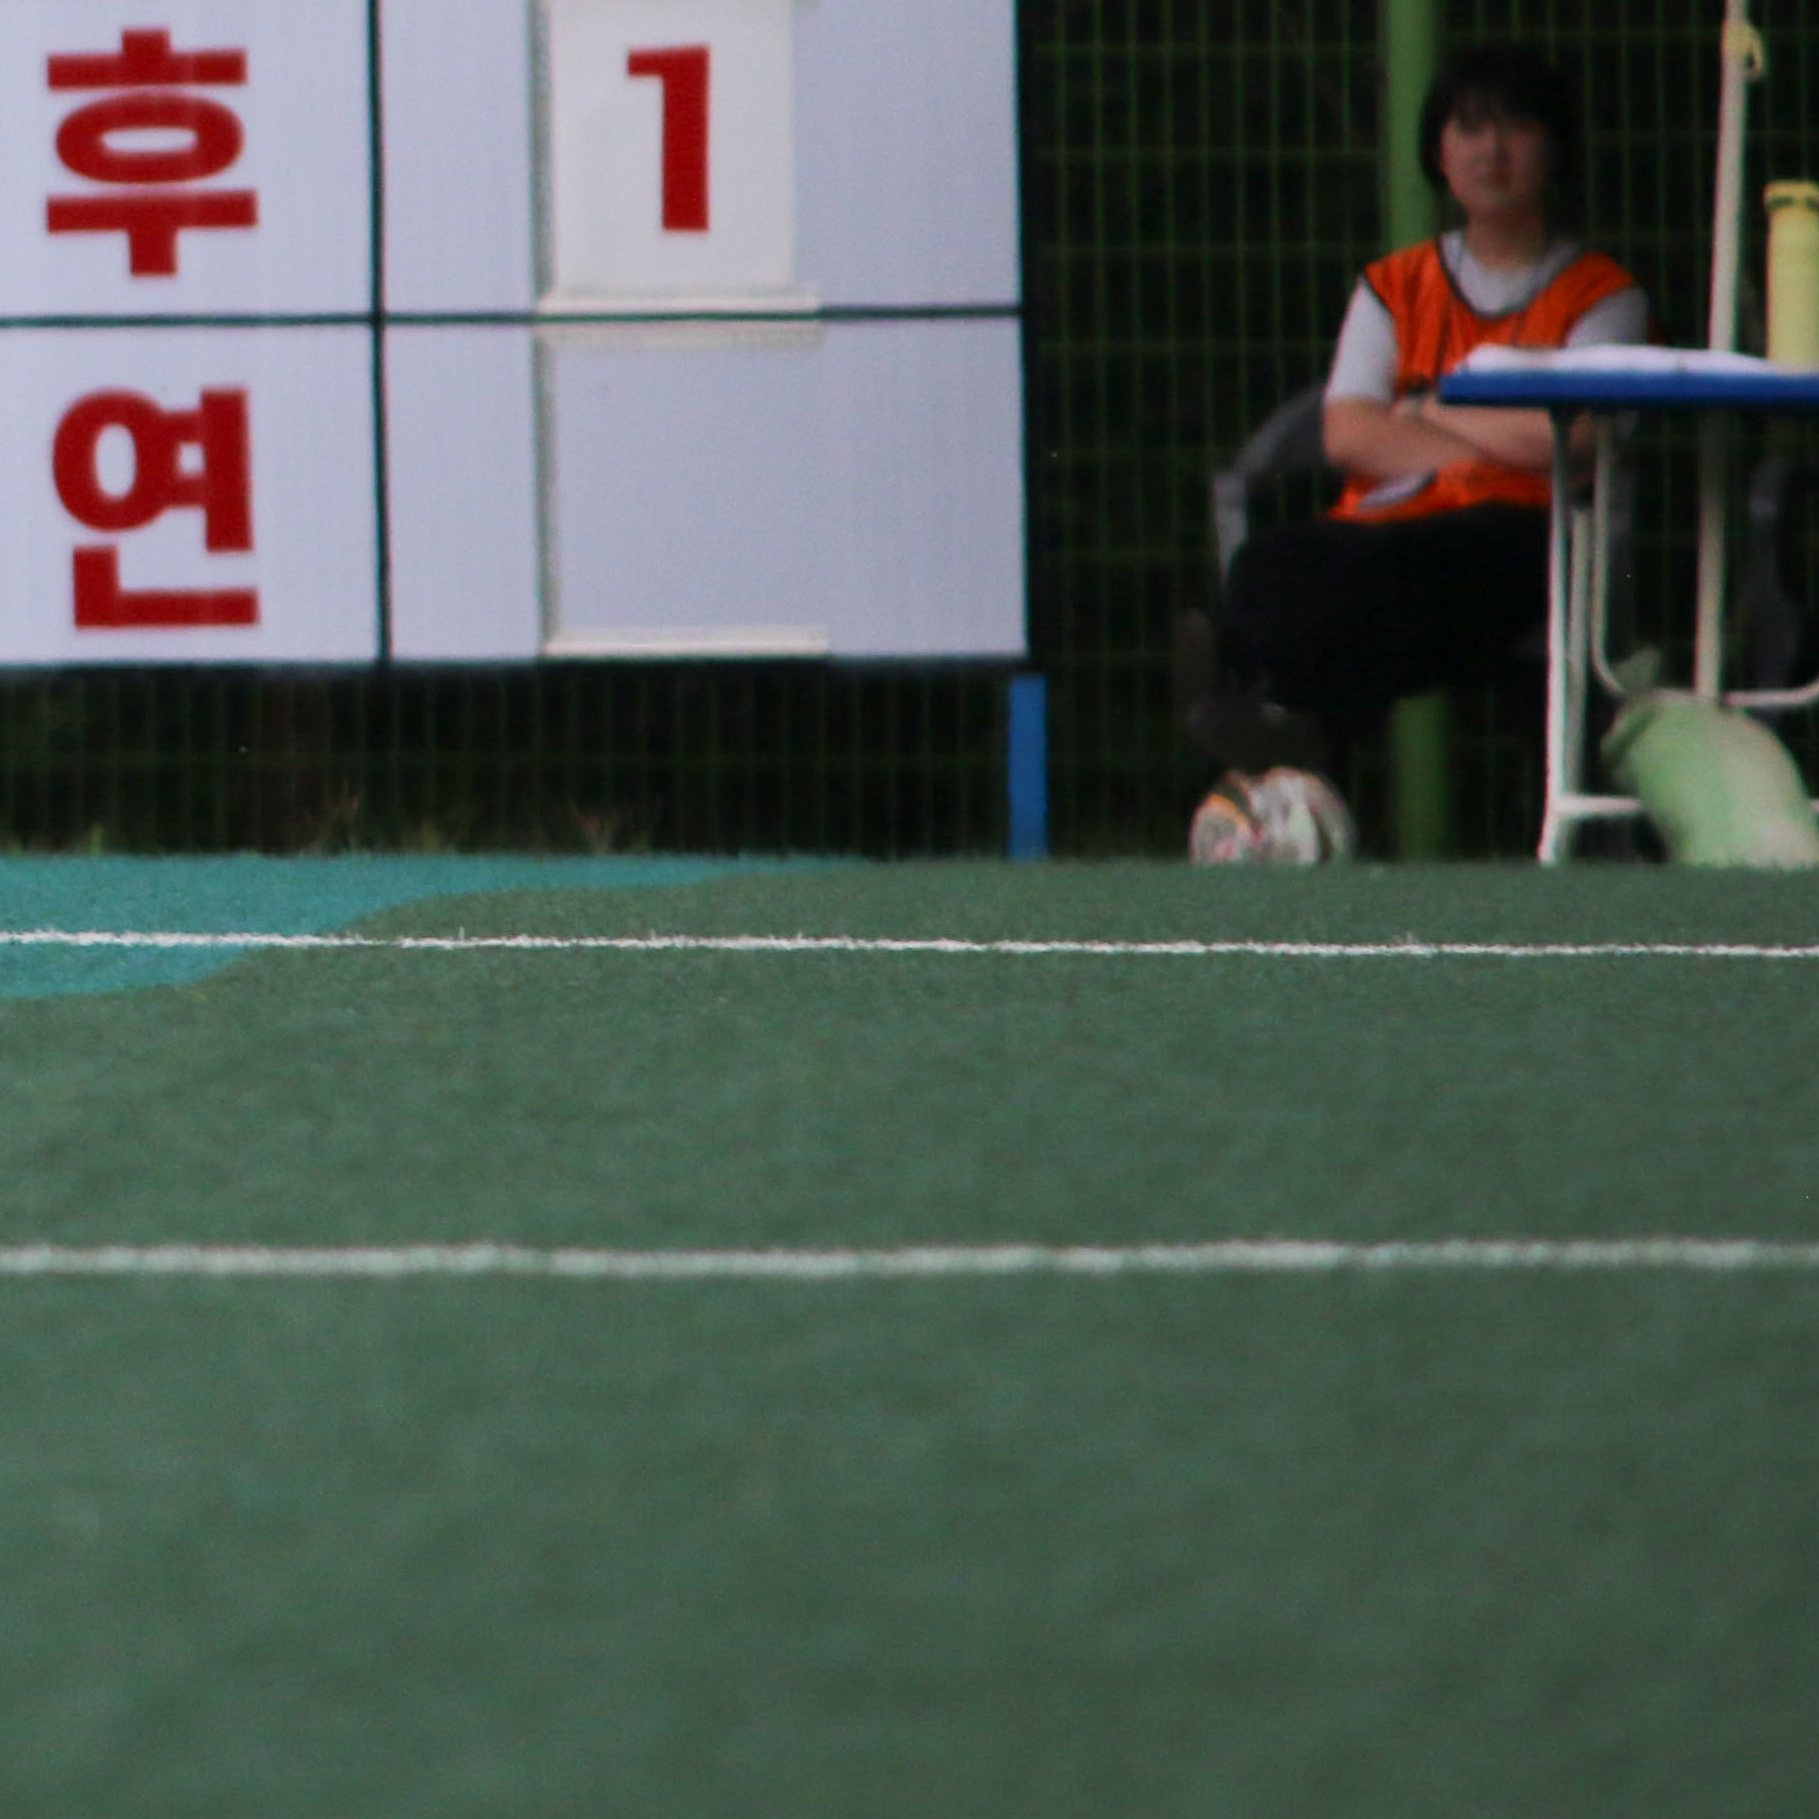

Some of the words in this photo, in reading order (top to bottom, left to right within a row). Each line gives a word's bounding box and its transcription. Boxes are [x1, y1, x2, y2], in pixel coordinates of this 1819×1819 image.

[45, 28, 259, 280] 후
[626, 44, 712, 234] 1
[51, 387, 261, 632] 연
